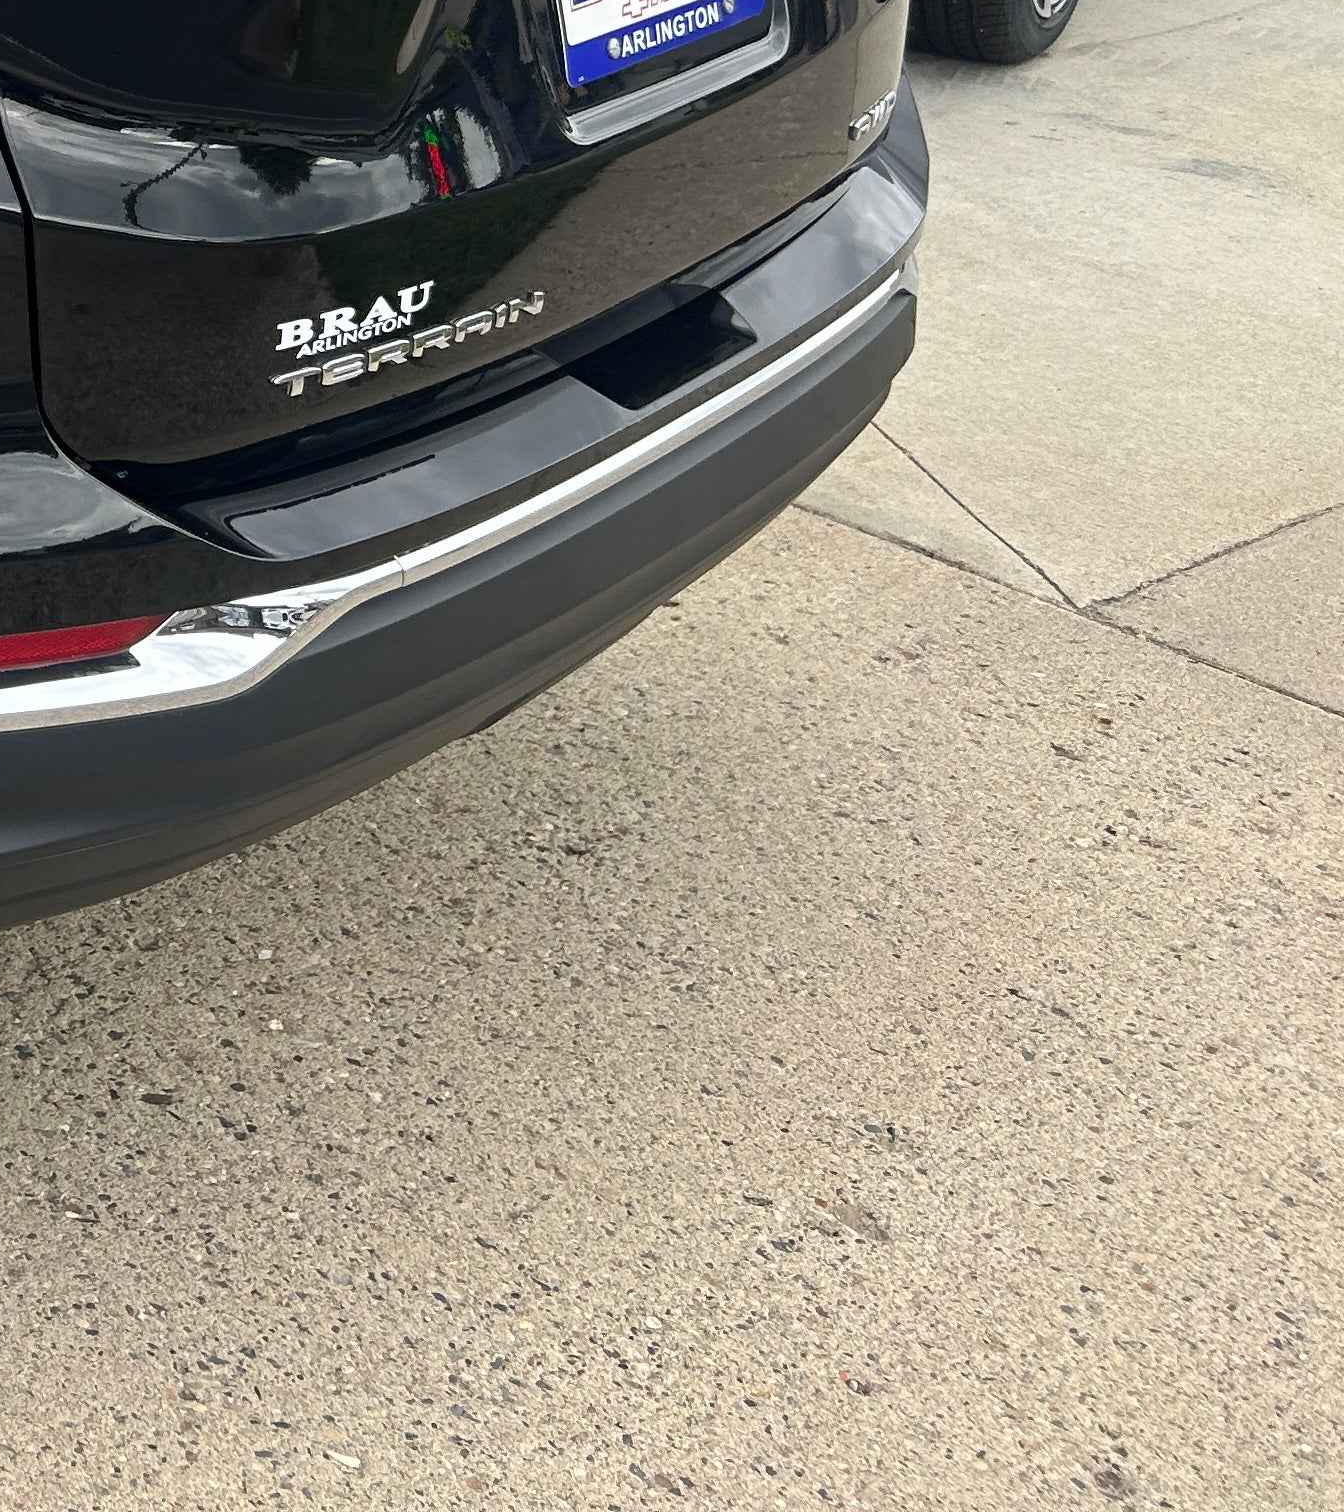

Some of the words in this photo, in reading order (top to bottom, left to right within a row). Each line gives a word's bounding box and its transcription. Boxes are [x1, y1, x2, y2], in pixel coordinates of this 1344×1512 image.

[621, 0, 720, 58] ARLINGTON
[269, 290, 546, 398] TERRAIN
[275, 280, 435, 351] BRAU
[296, 312, 412, 360] ARLINGTON
